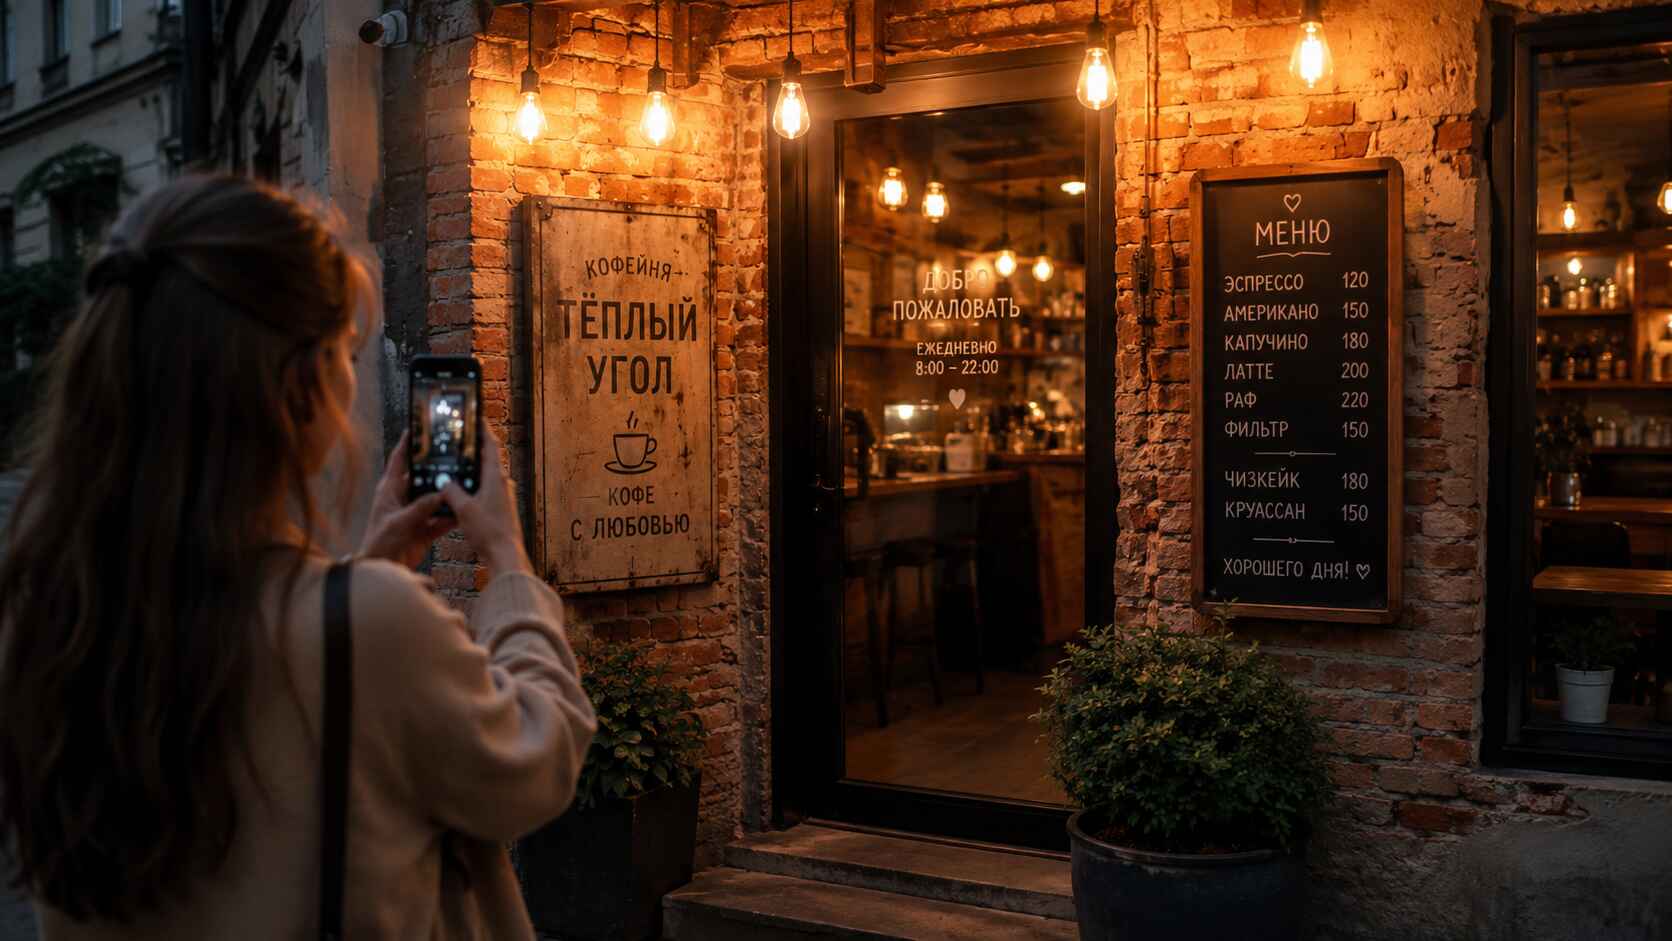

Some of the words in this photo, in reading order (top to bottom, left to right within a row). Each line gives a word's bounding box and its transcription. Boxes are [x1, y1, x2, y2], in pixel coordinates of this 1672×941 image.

[1255, 219, 1330, 246] МЕНЮ
[585, 254, 672, 282] КОФЕЙНЯ
[923, 269, 989, 294] ДОБРО
[1224, 274, 1304, 293] ЭСПРЕССО
[1342, 271, 1369, 289] 120
[557, 292, 697, 341] ТЁПЛЫЙ
[893, 298, 1021, 321] ПОЖАЛОВАТЬ
[1224, 303, 1319, 322] АМЕРИКАНО
[1342, 302, 1369, 319] 150
[917, 341, 997, 357] ЕЖЕДНЕВНО
[1225, 333, 1308, 351] КАПУЧИНО
[1342, 332, 1369, 349] 180
[587, 355, 672, 394] УГОЛ
[916, 361, 944, 376] 8:00
[961, 359, 999, 375] 22:00
[1224, 363, 1274, 380] ЛАТТЕ
[1341, 362, 1369, 379] 200
[1225, 391, 1257, 409] РАФ
[1341, 391, 1369, 408] 220
[1224, 420, 1289, 438] ФИЛЬТР
[1341, 421, 1369, 438] 150
[1225, 467, 1300, 489] ЧИЗКЕЙК
[1341, 472, 1369, 490] 180
[608, 486, 655, 506] КОФЕ
[1225, 501, 1305, 520] КРУАССАН
[1341, 504, 1369, 522] 150
[571, 520, 582, 541] С
[592, 513, 690, 540] ЛЮБОВЬЮ
[1223, 558, 1304, 577] ХОРОШЕГО
[1311, 561, 1349, 580] ДНЯ!
